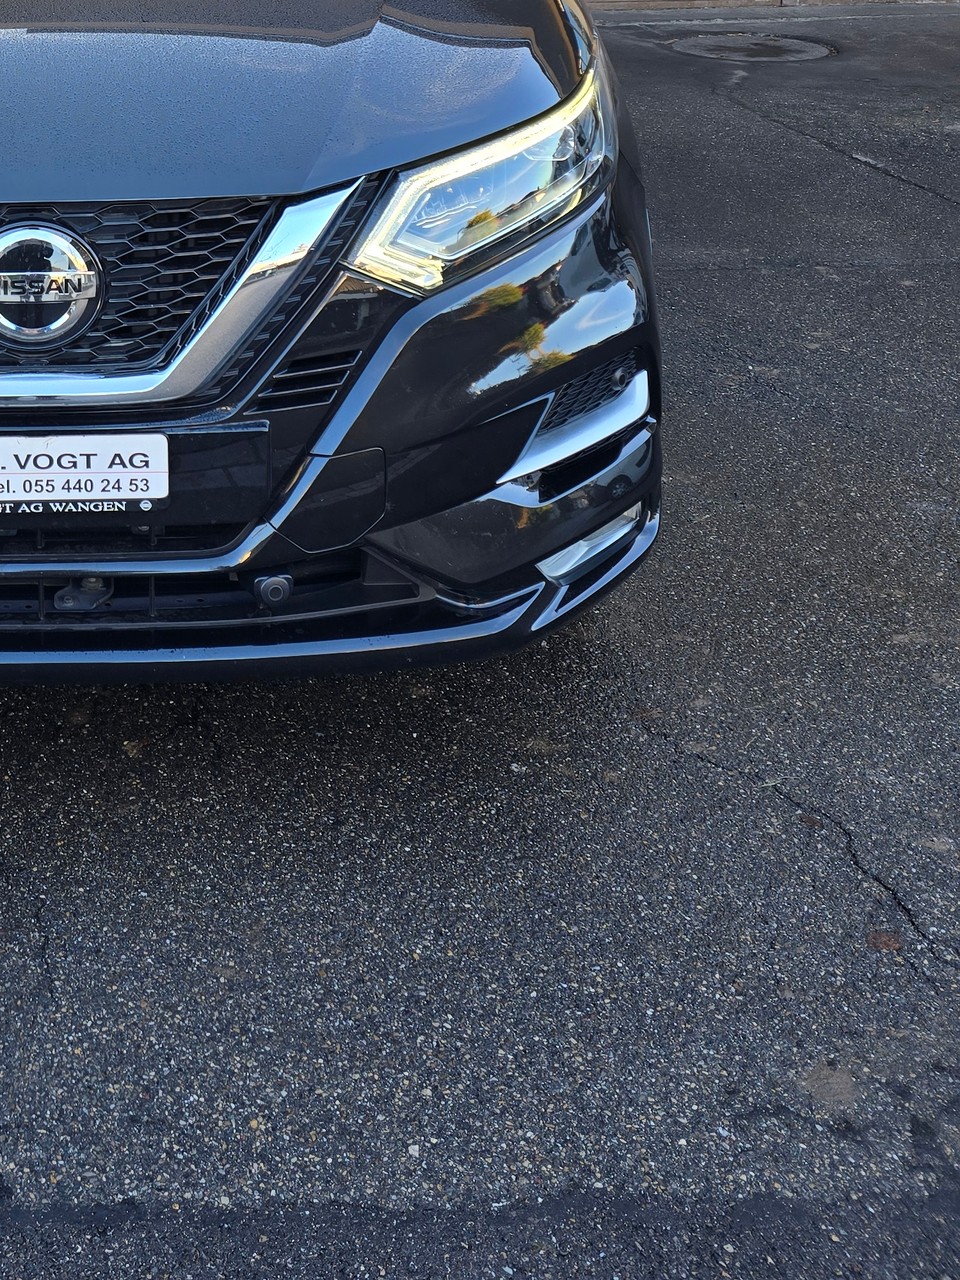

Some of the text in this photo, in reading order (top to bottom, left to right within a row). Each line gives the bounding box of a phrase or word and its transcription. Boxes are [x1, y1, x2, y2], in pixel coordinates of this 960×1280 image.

[13, 453, 97, 470] VOGT
[108, 452, 150, 469] AG
[23, 479, 55, 493] 055
[61, 478, 94, 493] 440
[100, 478, 122, 492] 24
[129, 478, 150, 492] 53
[18, 503, 44, 513] AG
[49, 501, 127, 512] WANGEN
